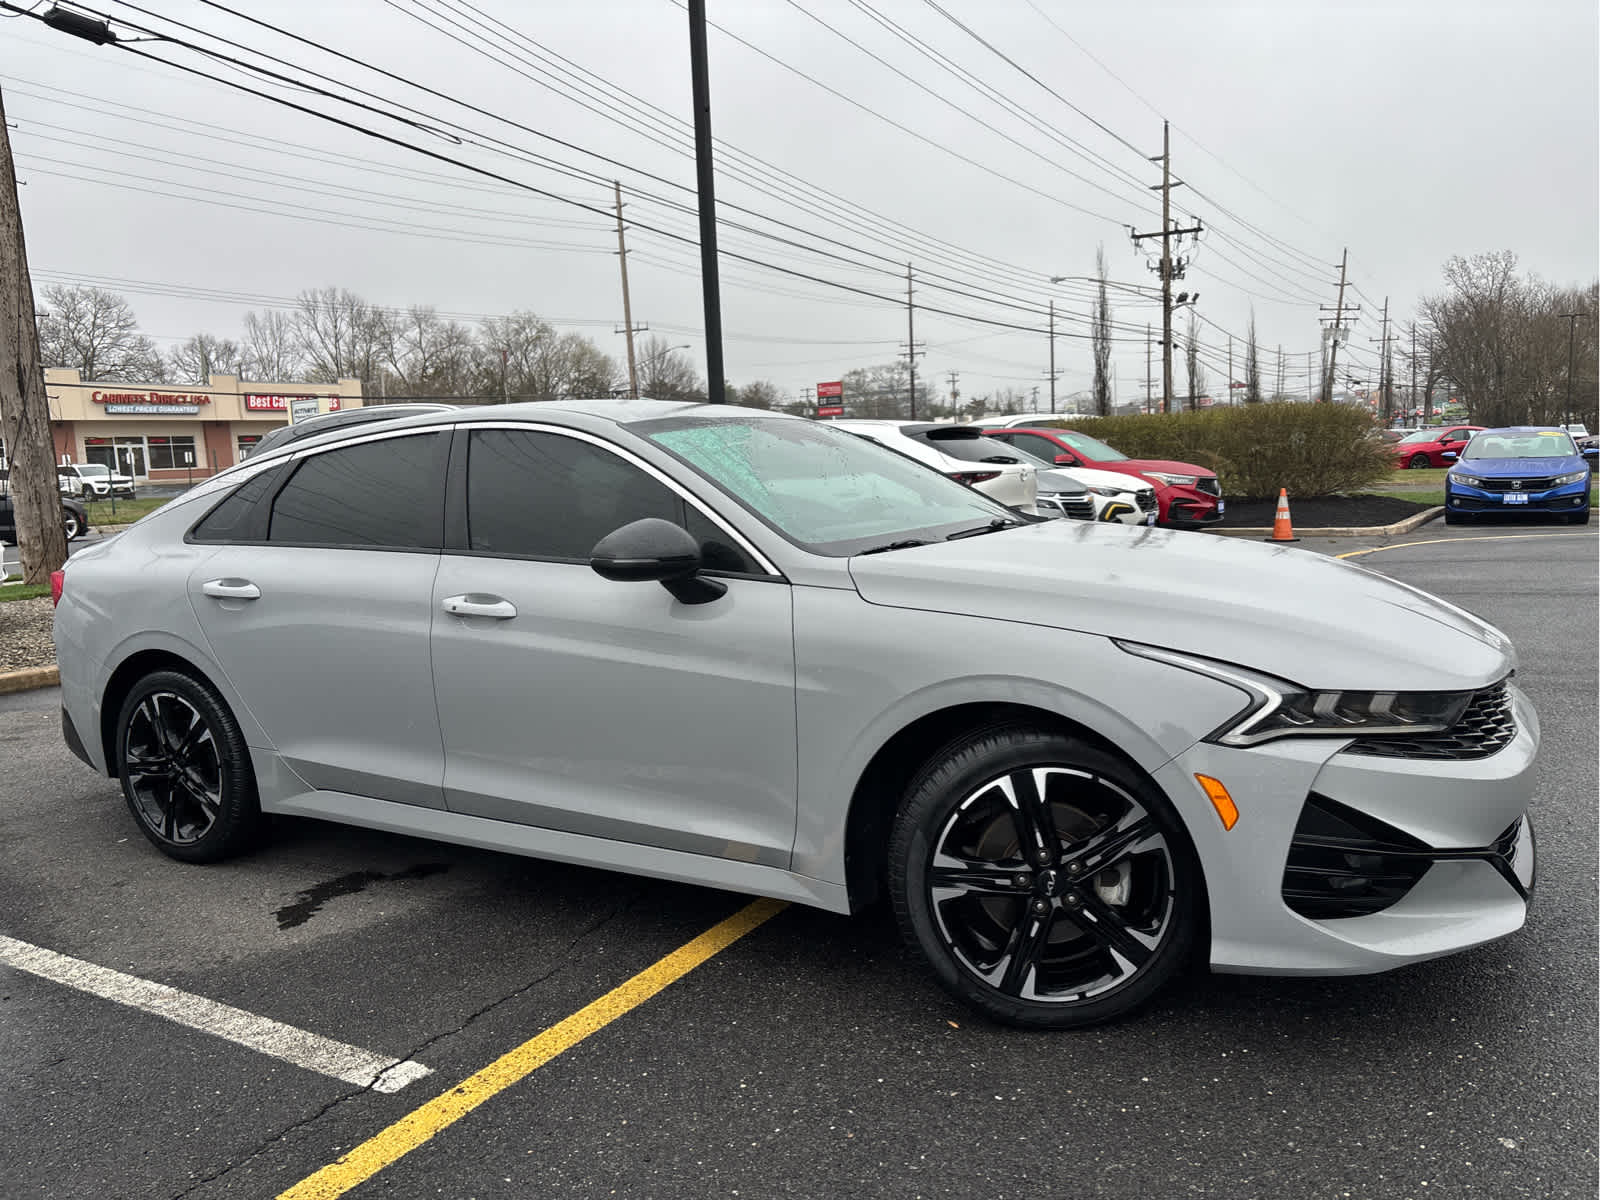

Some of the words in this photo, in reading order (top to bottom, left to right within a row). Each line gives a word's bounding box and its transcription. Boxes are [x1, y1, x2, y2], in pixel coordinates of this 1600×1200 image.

[92, 391, 147, 404] CABINETS
[149, 392, 188, 404] DIRECT
[190, 394, 211, 404] USA
[249, 395, 270, 408] Best
[108, 404, 134, 413] LOWEST
[135, 405, 157, 413] PRICES
[158, 405, 198, 414] GUARANTEED
